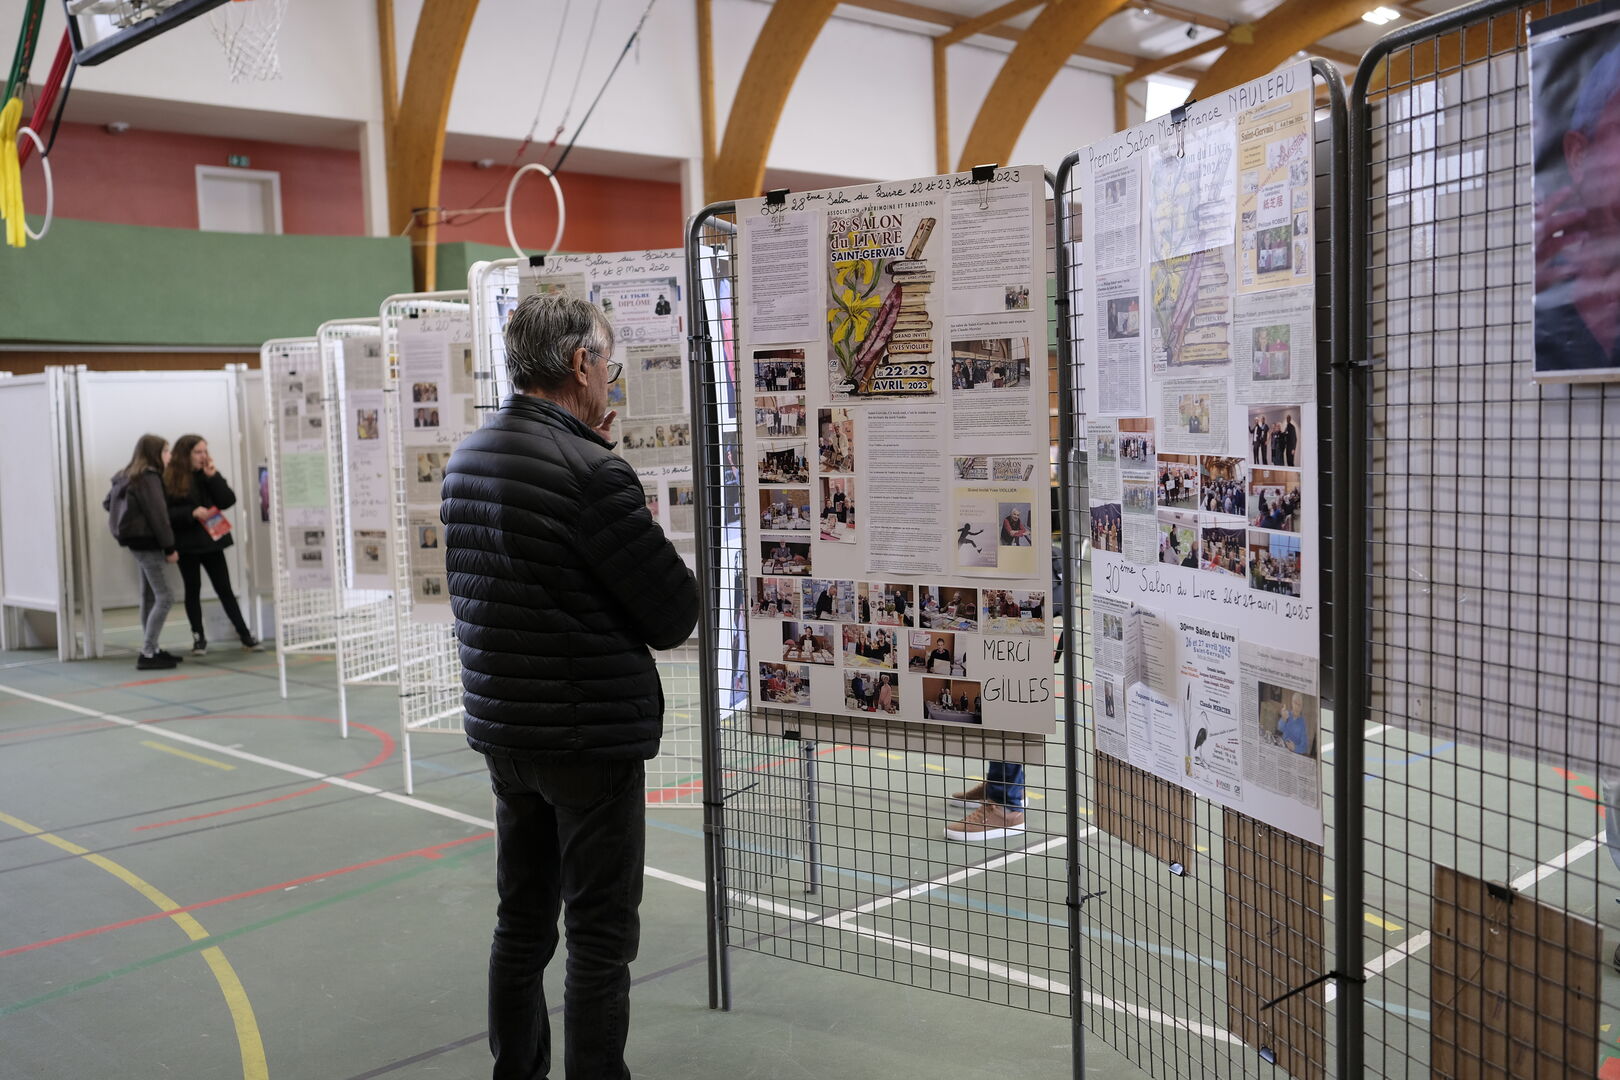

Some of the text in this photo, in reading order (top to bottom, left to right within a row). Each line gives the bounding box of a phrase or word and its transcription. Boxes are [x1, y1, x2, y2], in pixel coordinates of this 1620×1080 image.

[1089, 146, 1123, 173] Premier
[1125, 129, 1155, 158] Salon
[1229, 71, 1294, 113] NAULEAU
[826, 191, 851, 206] Salon
[854, 194, 869, 202] du
[874, 185, 906, 199] Livre
[909, 179, 923, 194] 22
[925, 182, 936, 191] et
[938, 179, 951, 190] 23
[827, 205, 860, 217] ASSOCIATION
[852, 213, 903, 232] SALON
[831, 231, 903, 250] du LIVRE
[585, 255, 612, 267] Salon
[831, 246, 905, 263] SAINT-GERVAIS
[625, 265, 646, 275] Mars
[649, 263, 671, 272] 2020
[885, 366, 903, 376] 22
[910, 365, 927, 376] 23
[873, 380, 904, 391] AVRIL
[1139, 566, 1173, 595] Salon
[1177, 580, 1187, 597] du
[1192, 574, 1217, 601] Livre
[1222, 587, 1233, 604] 26
[1233, 592, 1240, 606] et
[1242, 593, 1257, 610] 27
[1257, 598, 1278, 615] avril
[1284, 602, 1312, 624] 2025
[1195, 625, 1211, 637] Salon
[1211, 631, 1219, 639] du
[1220, 632, 1235, 644] Livre
[1199, 700, 1231, 715] Claude MERCIER
